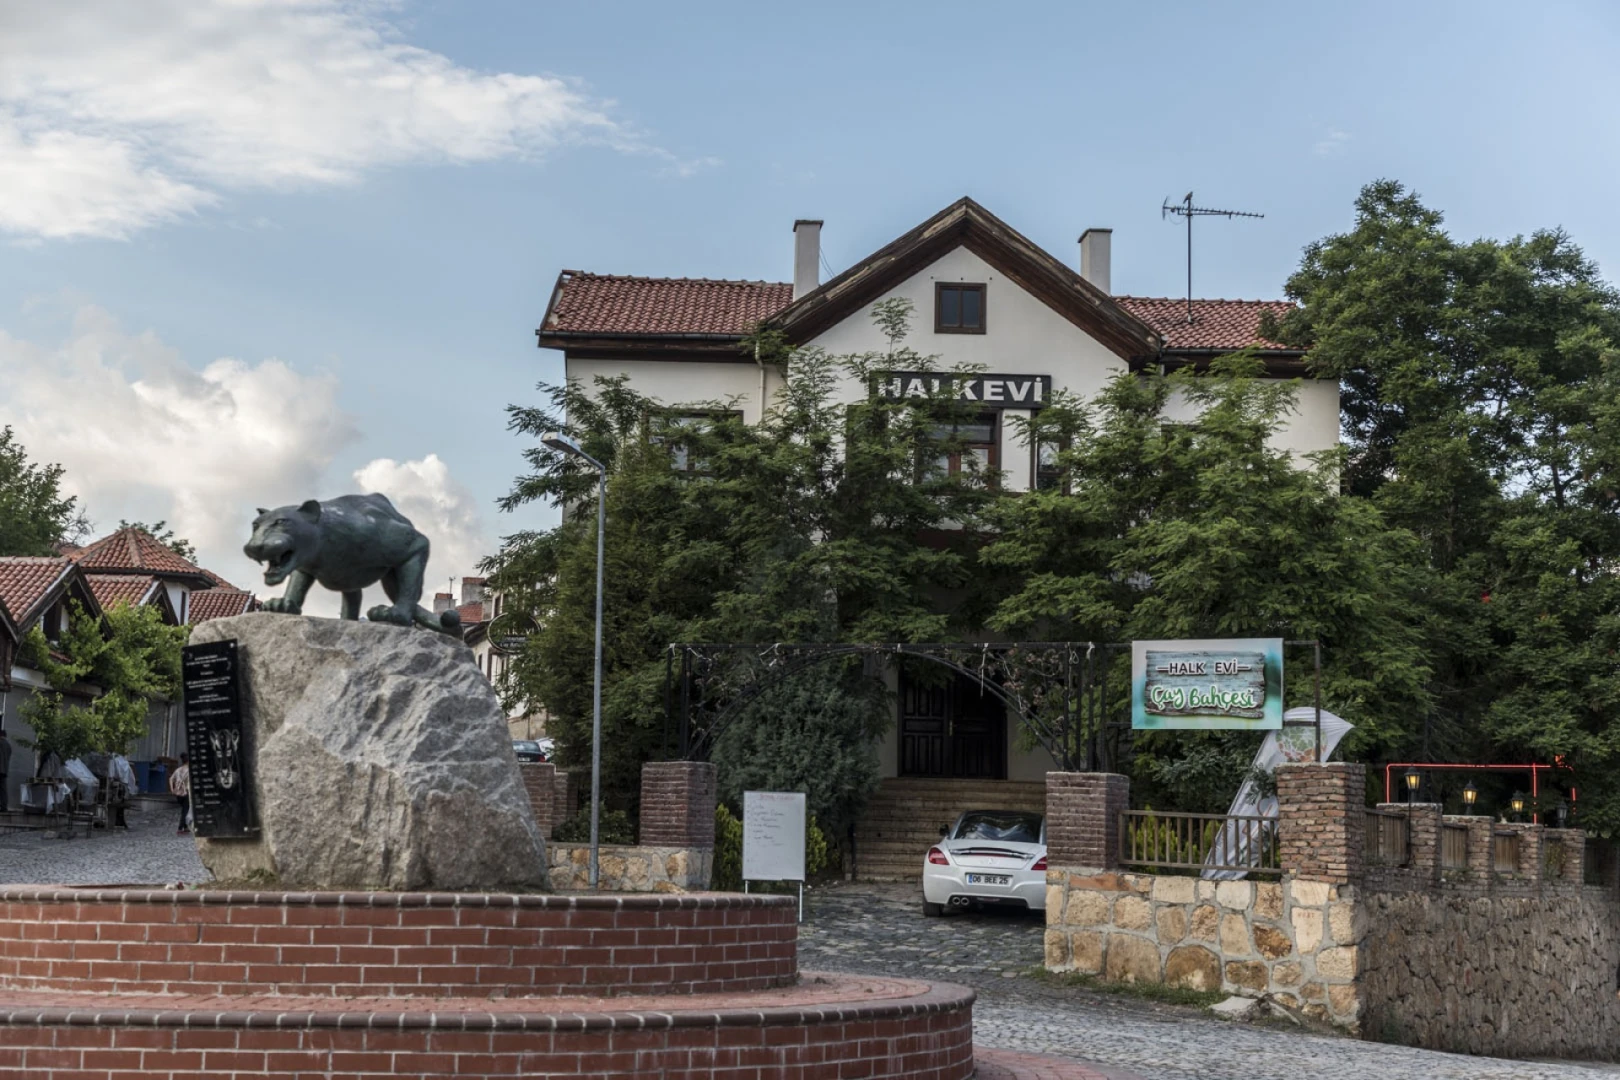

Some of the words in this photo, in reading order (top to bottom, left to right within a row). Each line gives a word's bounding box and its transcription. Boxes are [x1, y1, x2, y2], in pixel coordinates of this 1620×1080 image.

[1168, 662, 1206, 675] HALK
[1214, 658, 1238, 675] EVİ
[1151, 686, 1185, 710] Çay
[1189, 685, 1257, 711] Bahçesi
